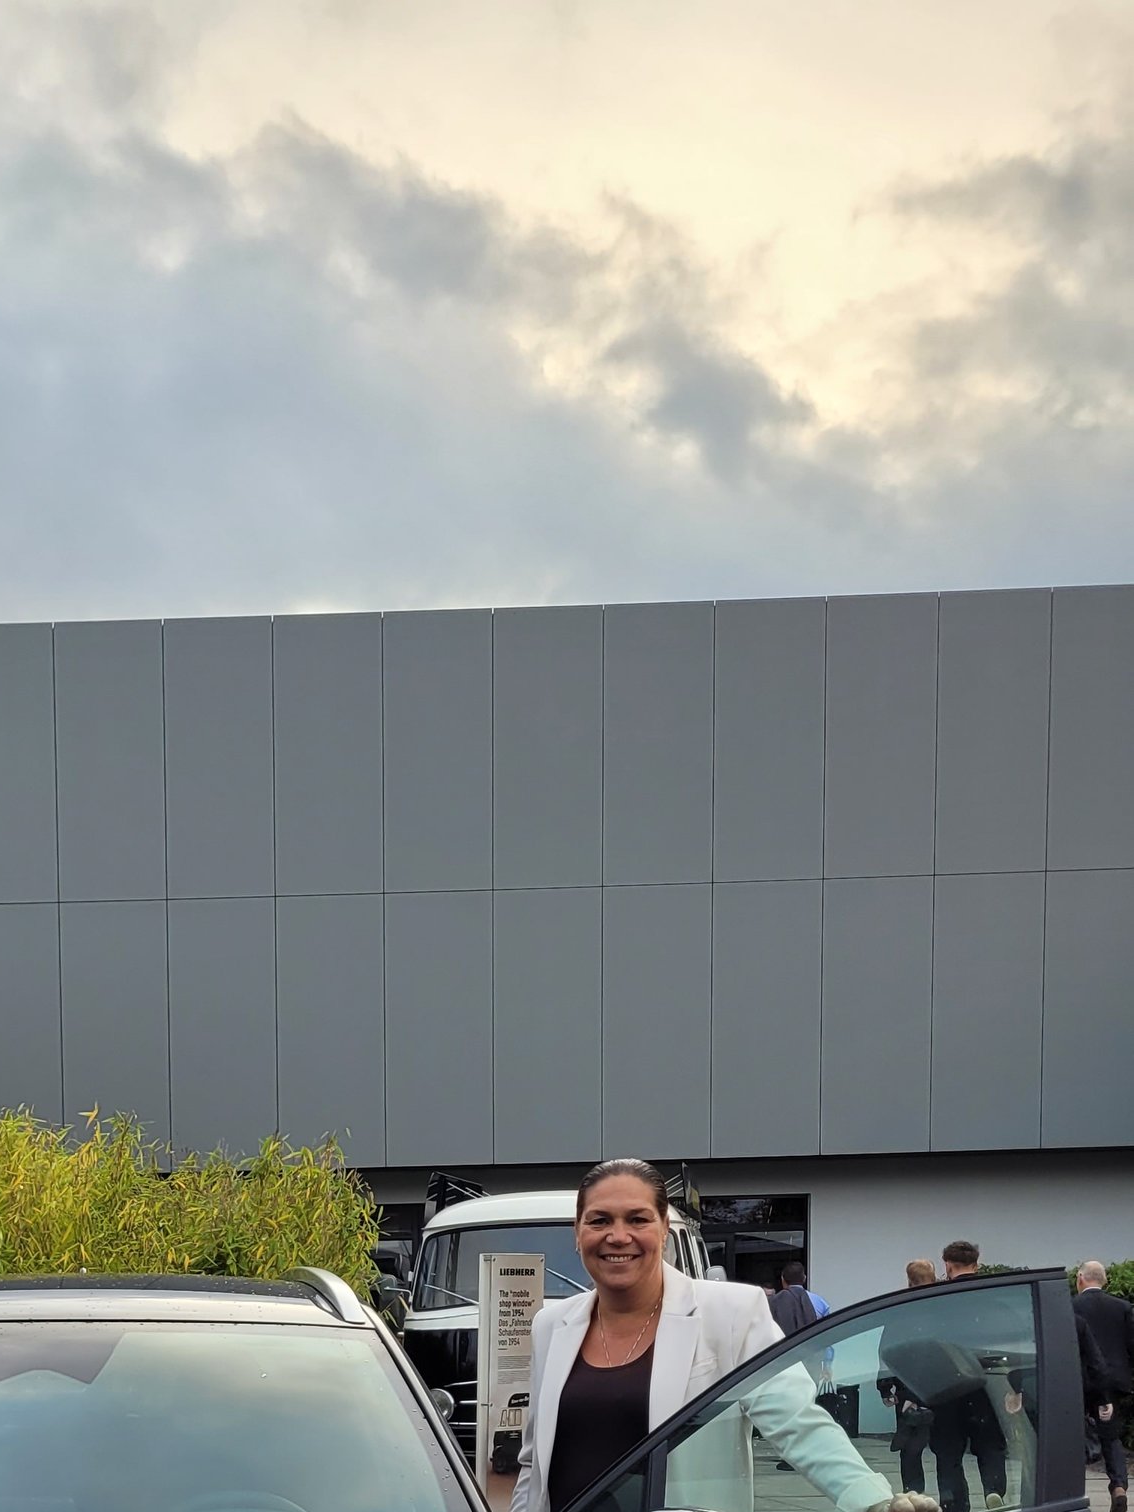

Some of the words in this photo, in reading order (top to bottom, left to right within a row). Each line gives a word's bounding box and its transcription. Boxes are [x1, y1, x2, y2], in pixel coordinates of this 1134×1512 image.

[499, 1268, 535, 1276] LIEBHERR
[499, 1300, 511, 1308] shop
[498, 1309, 512, 1317] from
[512, 1308, 525, 1317] 1954
[499, 1319, 508, 1327] Das
[508, 1338, 520, 1346] 1954
